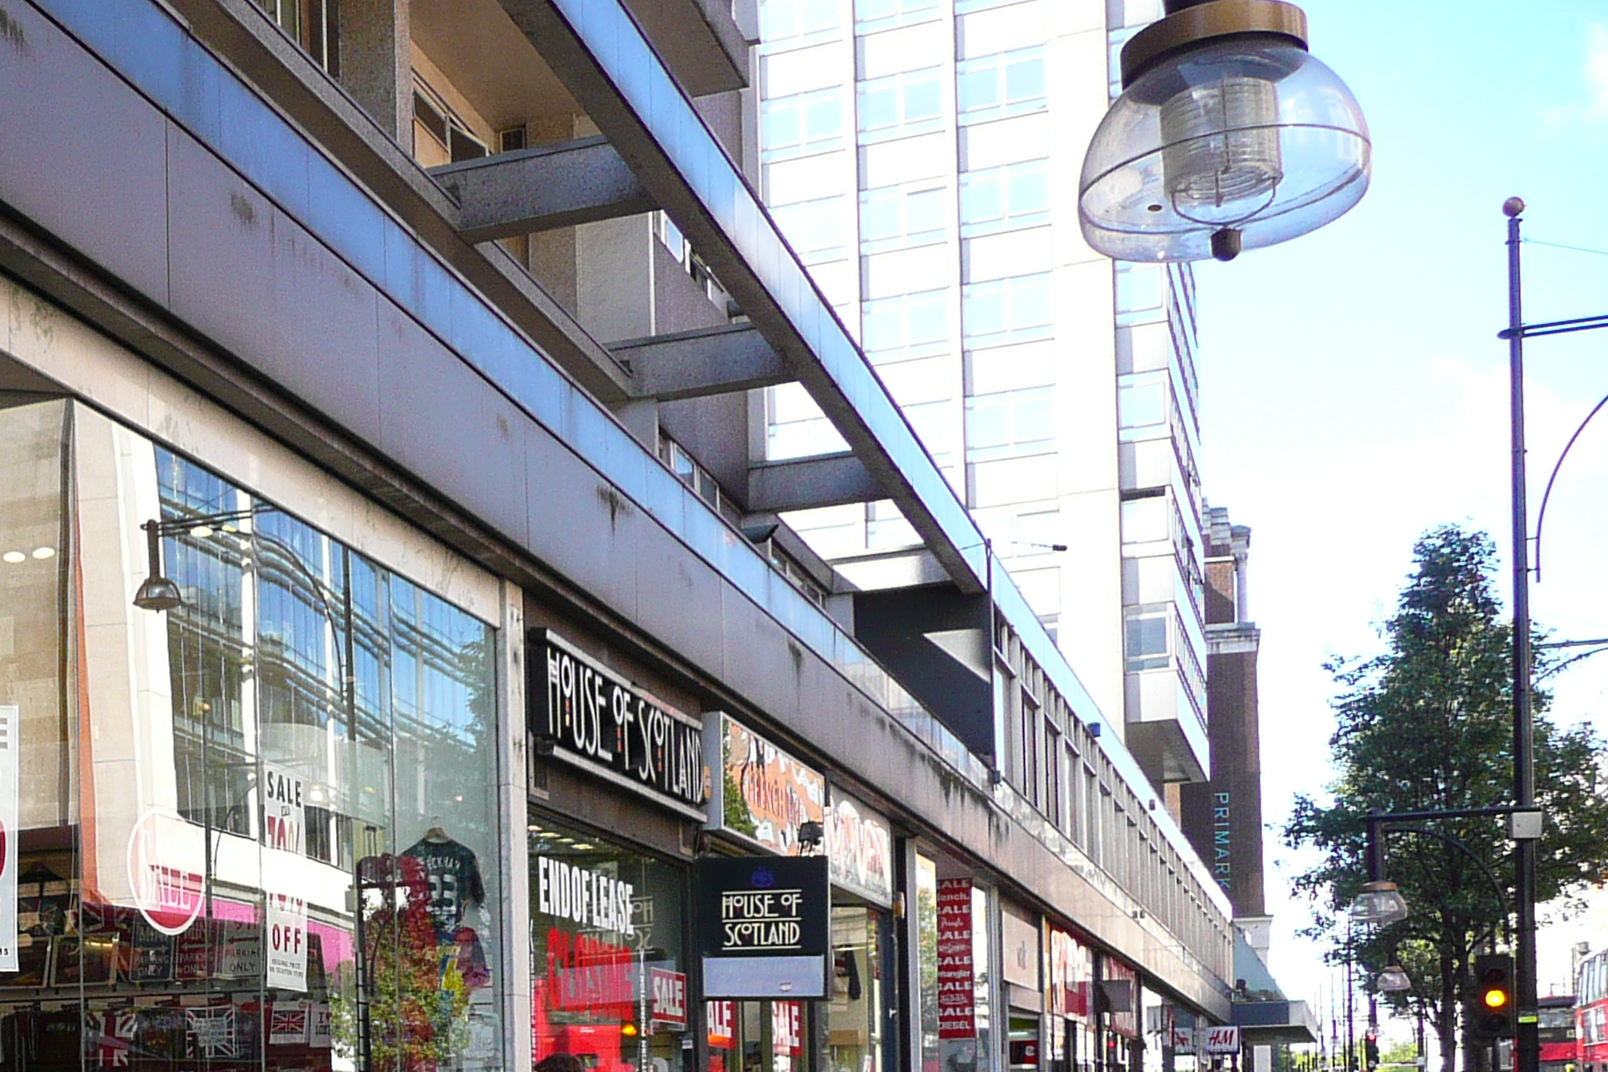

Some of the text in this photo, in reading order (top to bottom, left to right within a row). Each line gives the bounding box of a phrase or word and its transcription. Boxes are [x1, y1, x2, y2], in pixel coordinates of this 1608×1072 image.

[547, 647, 613, 762] HOUSE
[613, 686, 634, 770] OF
[638, 700, 704, 804] SCOTLAND
[267, 771, 301, 808] SALE
[1214, 792, 1231, 889] PRIMARK
[538, 856, 570, 918] END
[572, 866, 589, 924] OF
[592, 872, 634, 935] LEASE
[722, 894, 803, 918] HOUSE OF
[272, 923, 302, 954] OFF
[723, 922, 800, 946] SCOTLAND
[654, 976, 684, 1017] SALE
[707, 1001, 732, 1037] ALE
